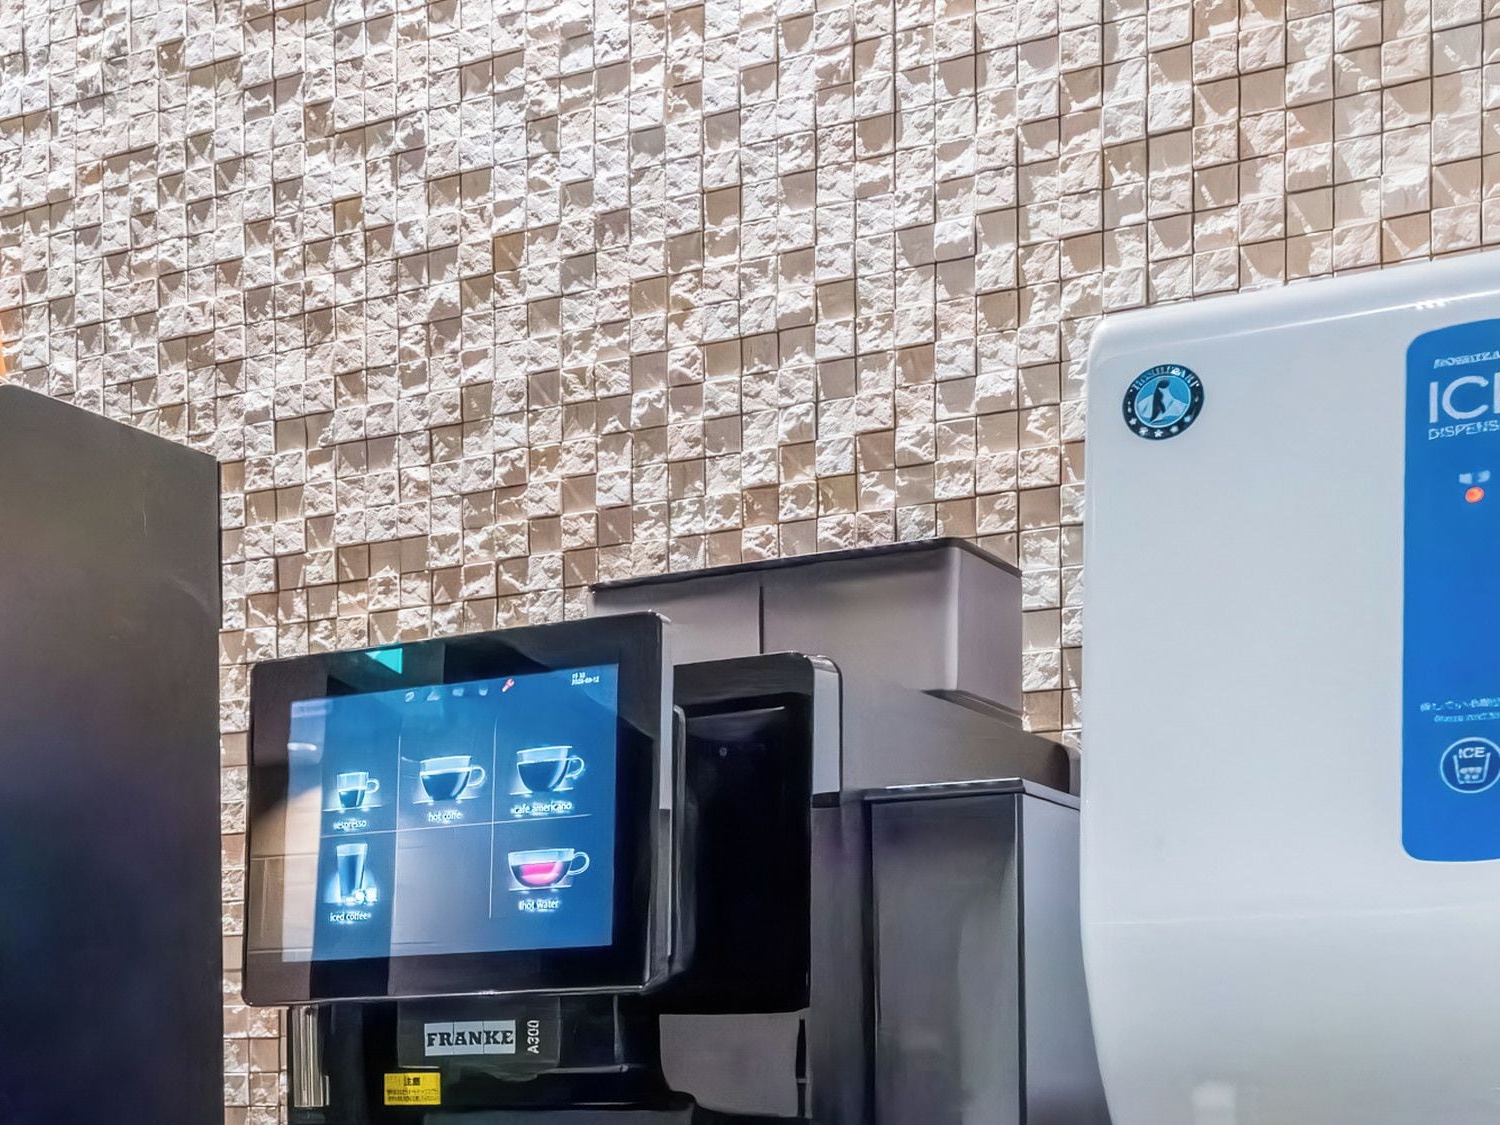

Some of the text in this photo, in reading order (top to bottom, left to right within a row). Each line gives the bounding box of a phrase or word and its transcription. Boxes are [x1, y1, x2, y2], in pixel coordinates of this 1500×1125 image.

[1429, 372, 1500, 423] IC
[1458, 747, 1486, 759] ICE
[531, 800, 573, 814] americano
[428, 811, 442, 822] hot
[536, 899, 560, 911] water
[330, 912, 345, 922] iced
[426, 1030, 514, 1048] FRANKE
[526, 1019, 540, 1054] A300
